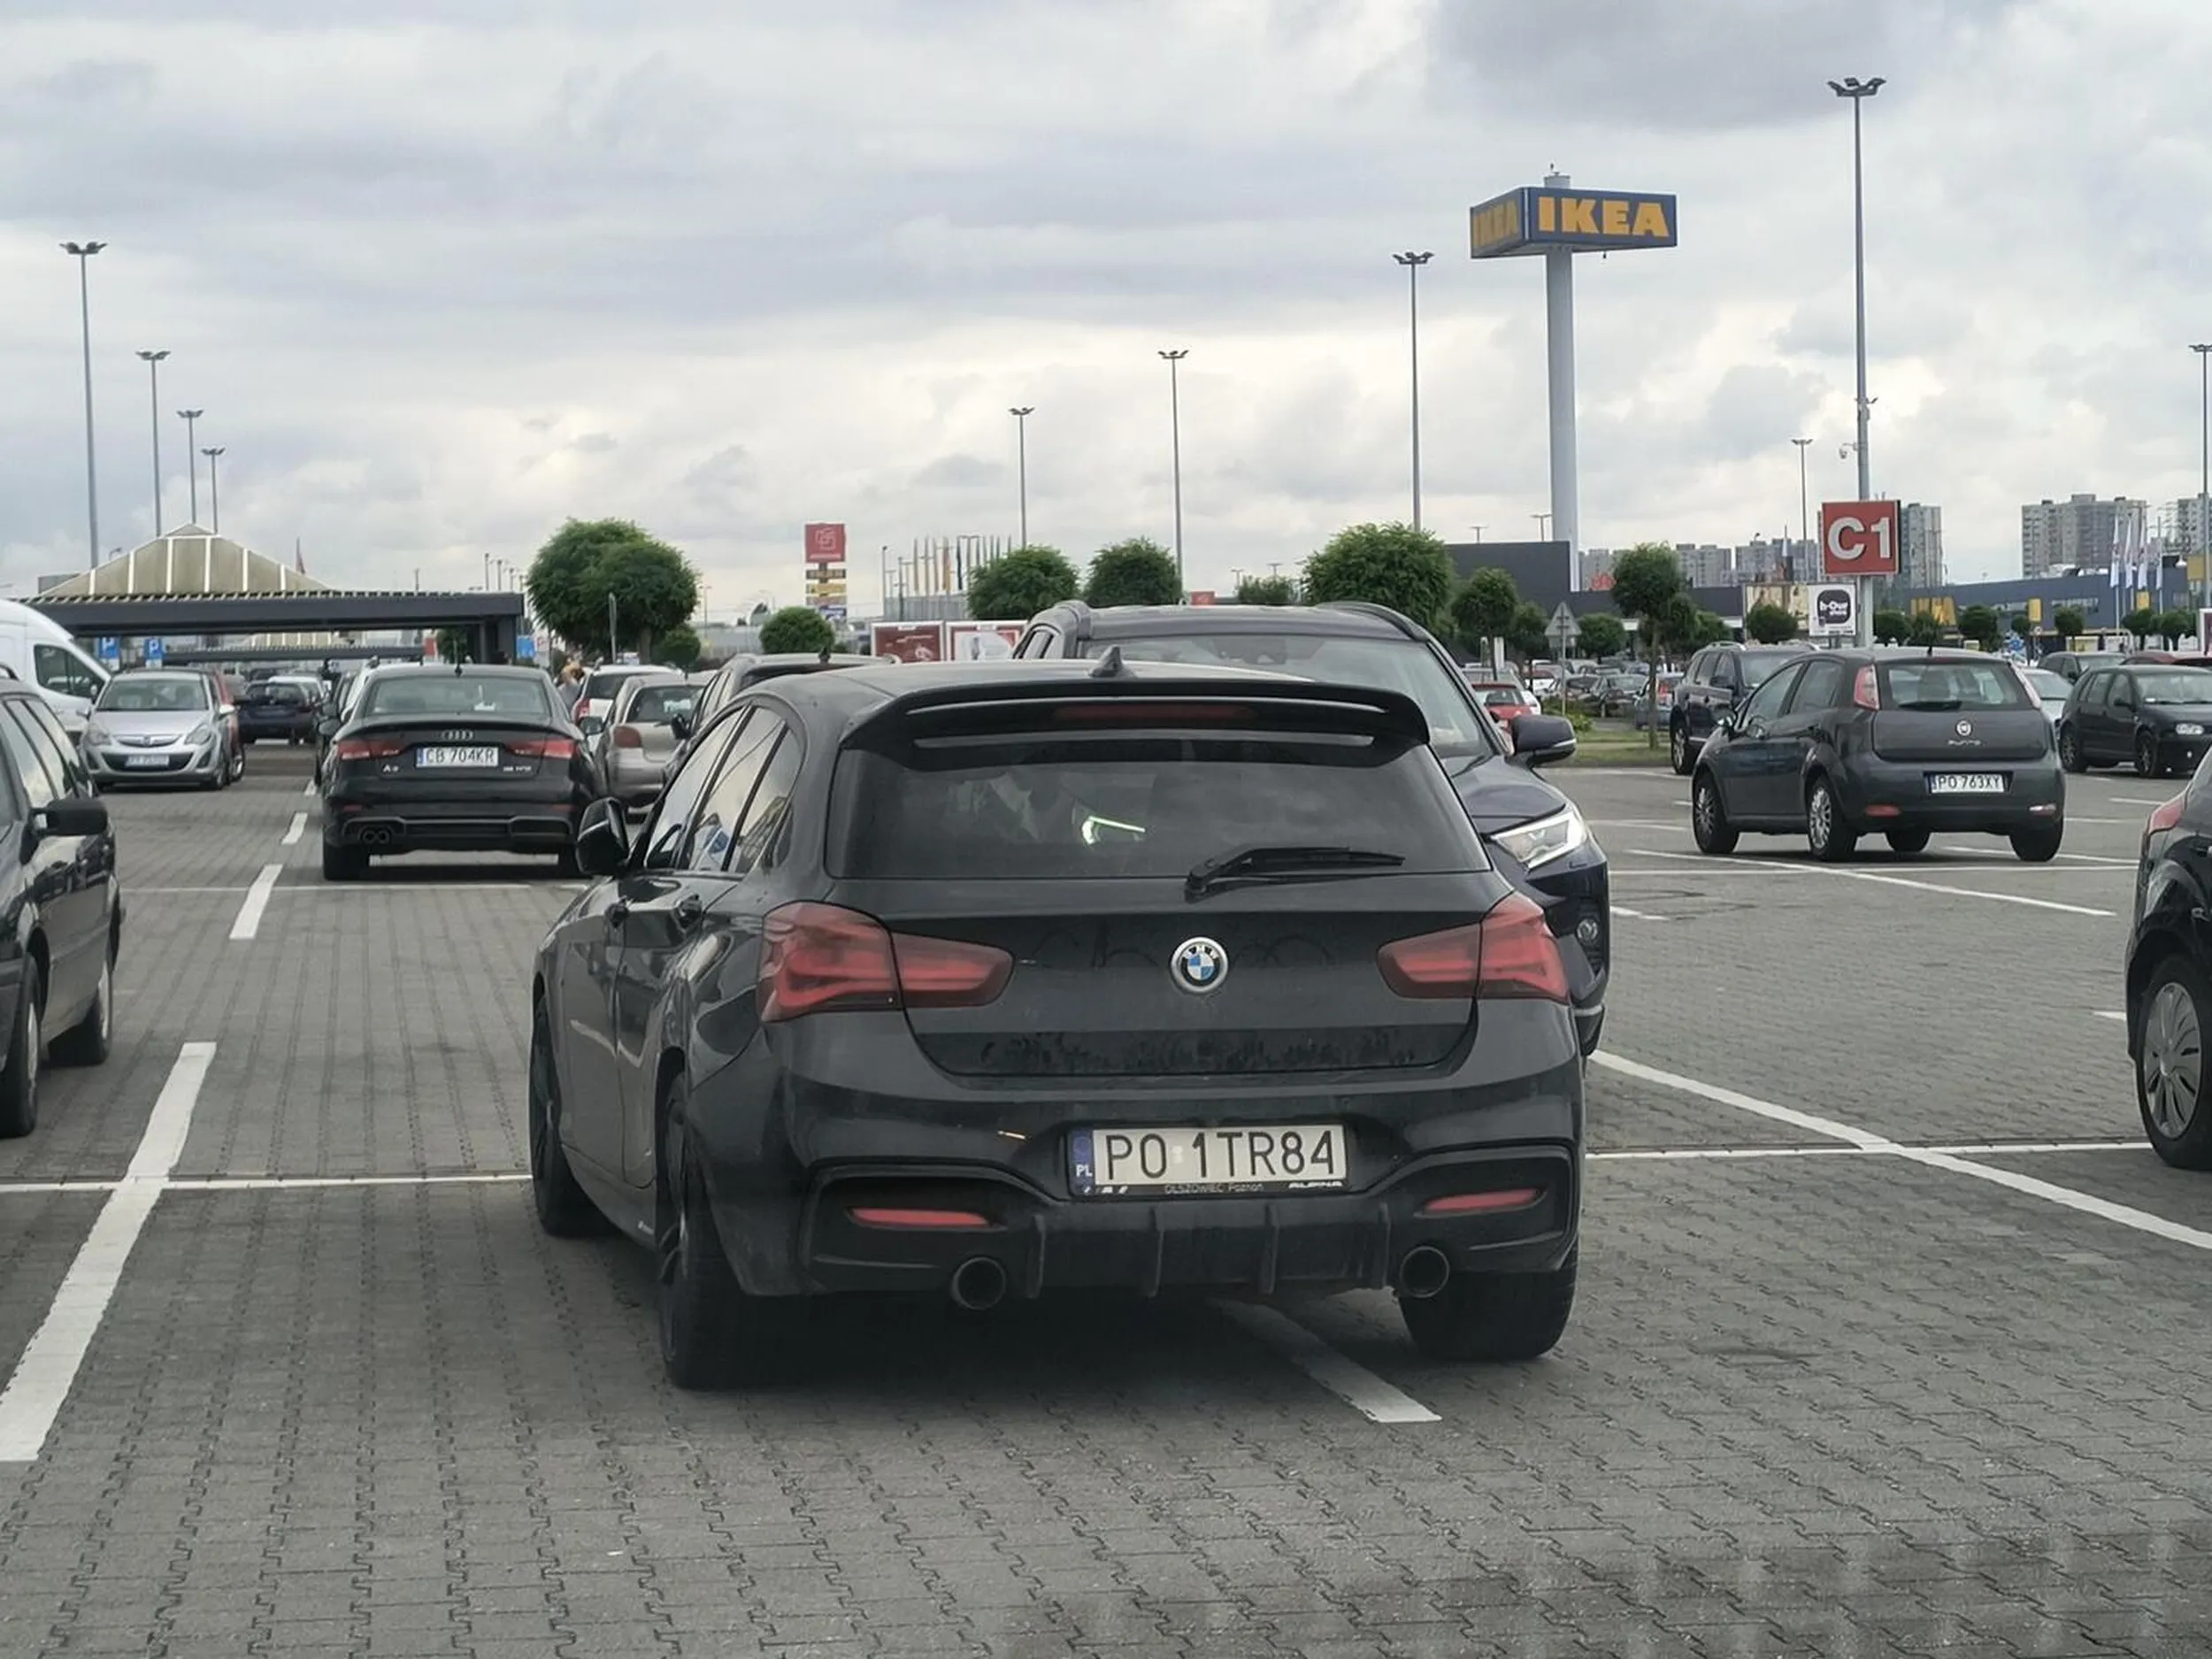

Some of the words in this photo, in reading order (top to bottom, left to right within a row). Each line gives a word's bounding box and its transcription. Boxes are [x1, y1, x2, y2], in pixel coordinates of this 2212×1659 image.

[1473, 201, 1518, 248] IKEA
[1538, 196, 1670, 237] IKEA
[1827, 517, 1891, 559] C1
[426, 748, 445, 763] CB
[1939, 775, 1957, 789] PO
[1076, 1164, 1093, 1177] PL
[1105, 1133, 1167, 1180] PO
[1192, 1130, 1334, 1179] 1TR84
